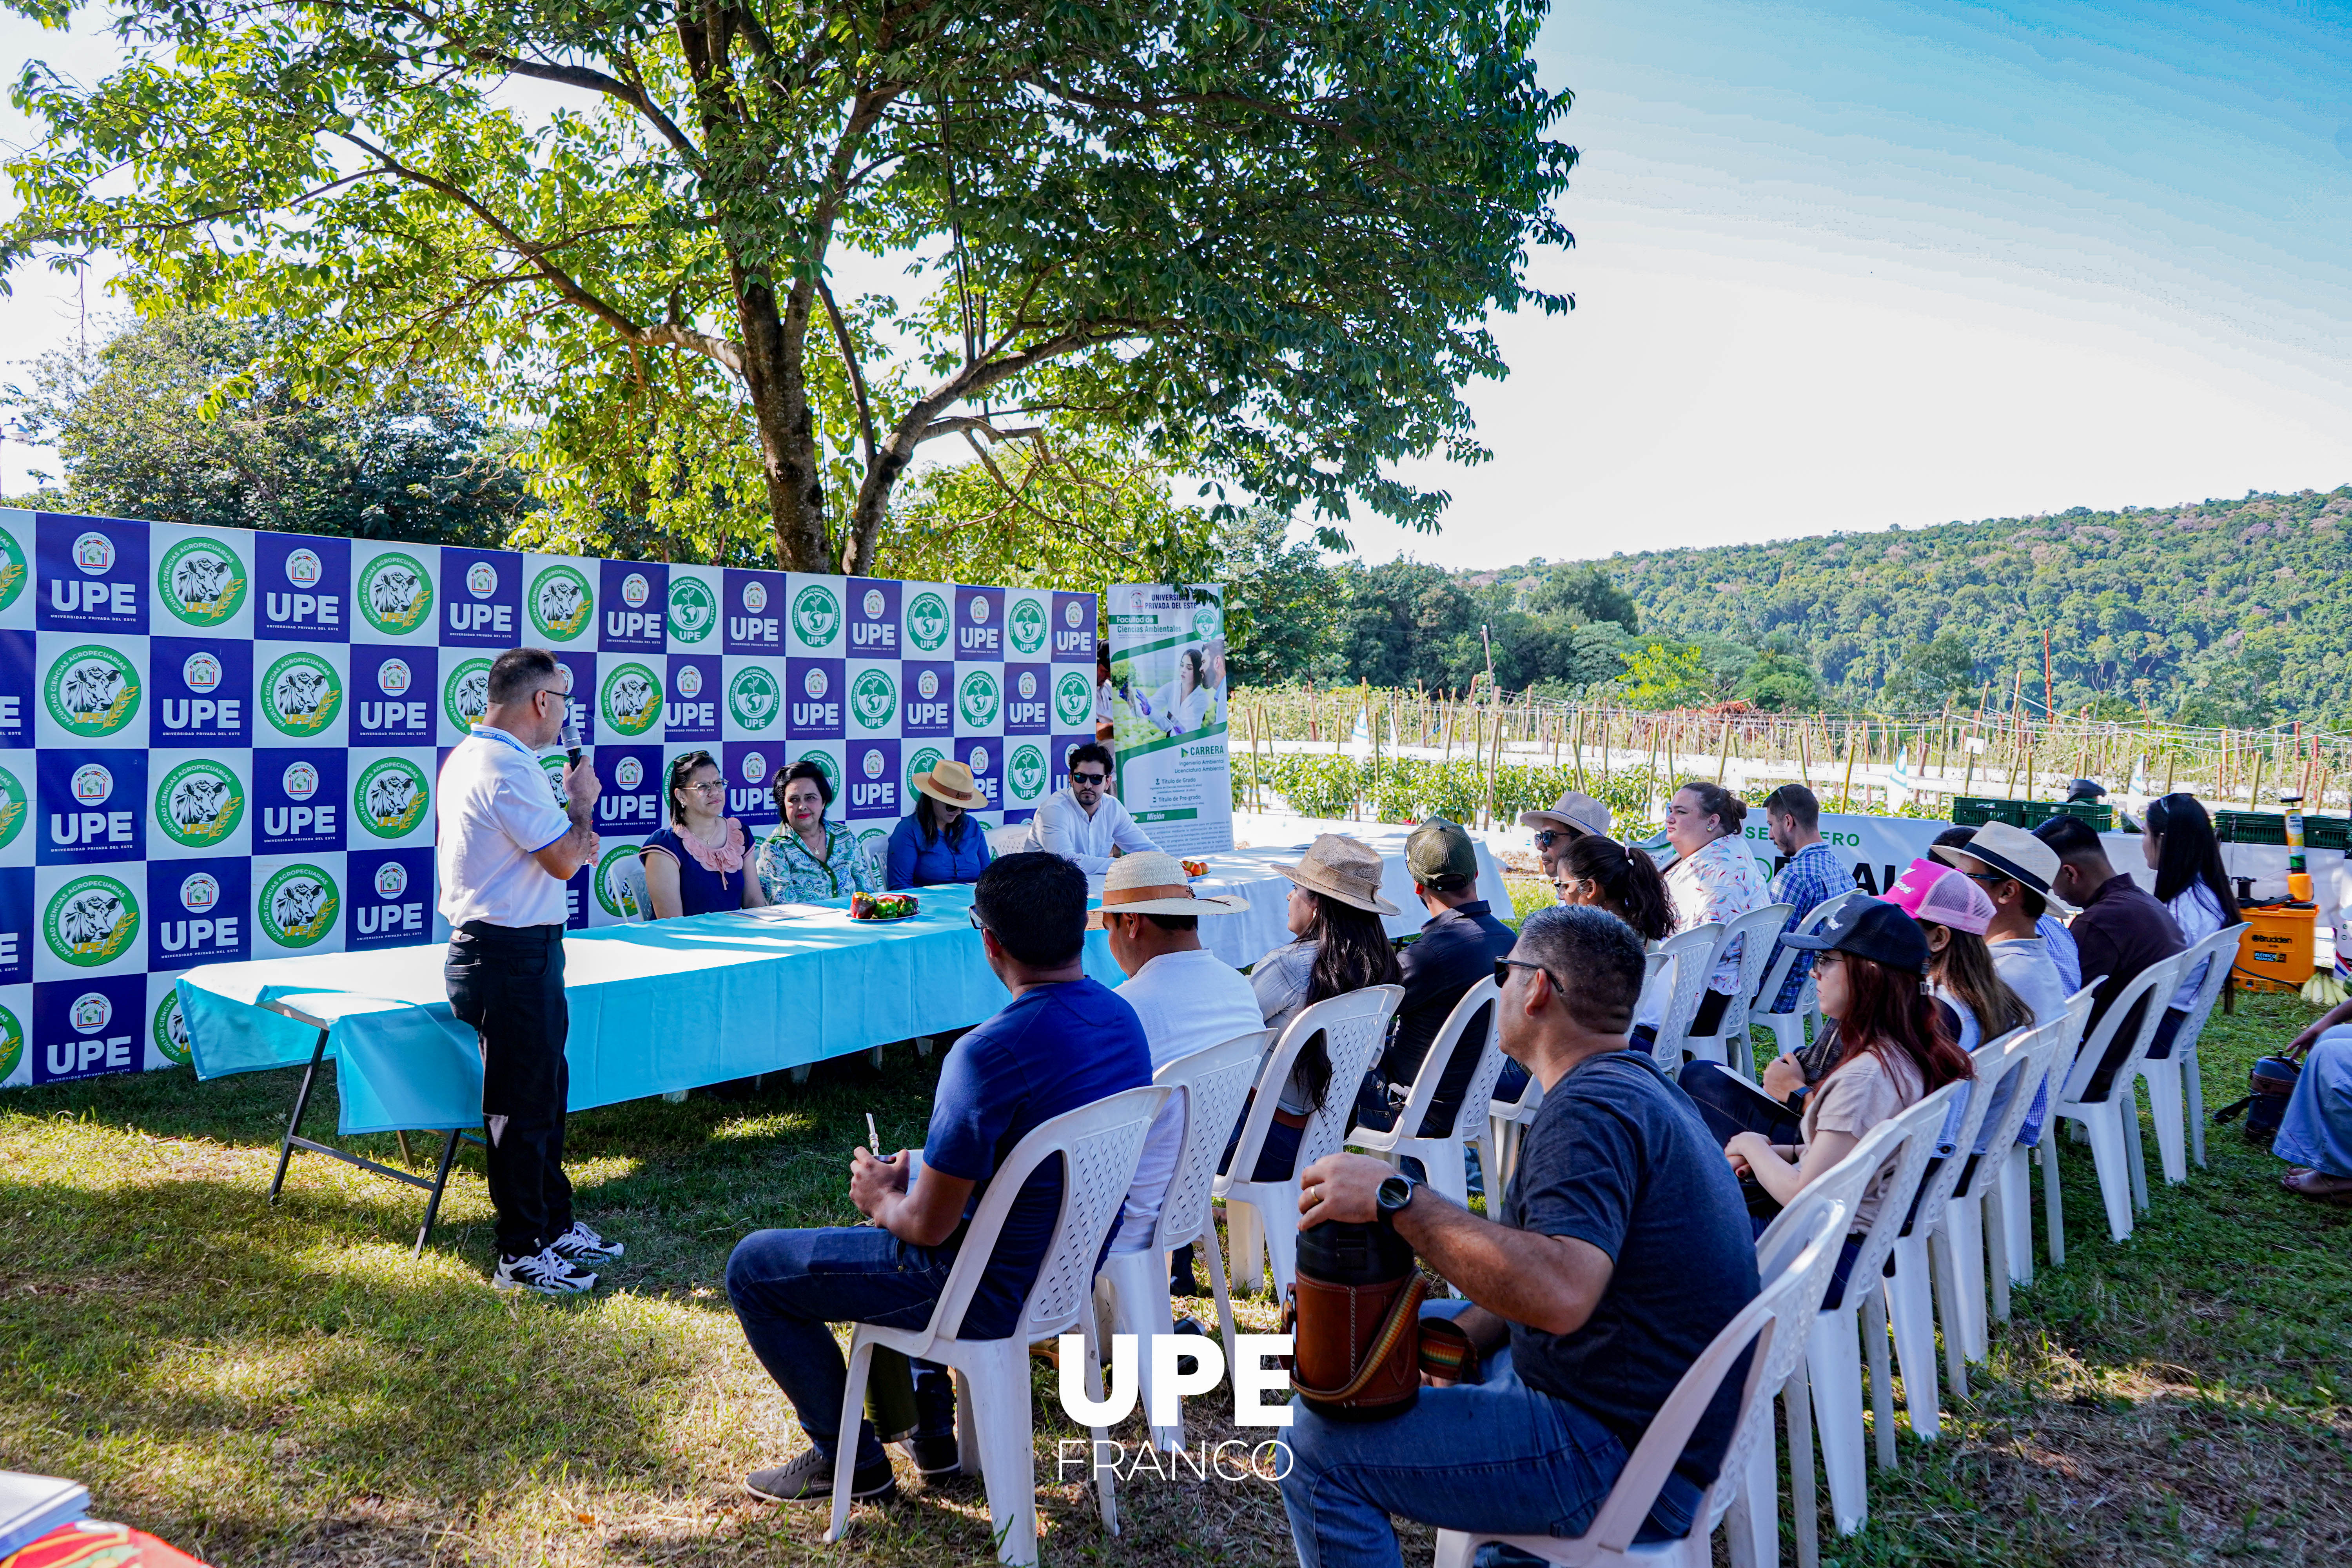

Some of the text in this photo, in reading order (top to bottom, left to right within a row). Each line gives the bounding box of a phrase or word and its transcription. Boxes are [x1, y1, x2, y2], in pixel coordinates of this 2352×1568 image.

[164, 543, 233, 614] FACULTAD CIENCIAS AGROPECUARIAS
[363, 557, 422, 623] FACULTAD CIENCIAS AGROPECUARIAS
[52, 579, 136, 614] UPE
[185, 602, 213, 614] UPE
[267, 592, 338, 624] UPE
[532, 570, 584, 631] FACULTAD CIENCIAS AGROPECUARIAS
[702, 586, 715, 624] AMBIENTALES
[381, 612, 405, 623] UPE
[450, 603, 512, 631] UPE
[548, 620, 568, 630] UPE
[608, 612, 661, 638] UPE
[679, 631, 701, 641] UPE
[731, 617, 778, 641] UPE
[853, 623, 895, 645] UPE
[961, 627, 998, 648] UPE
[807, 636, 826, 646] UPE
[920, 640, 937, 649] UPE
[1056, 631, 1091, 651] UPE
[51, 651, 127, 725] FACULTAD CIENCIAS AGROPECUARIAS
[266, 657, 330, 726] FACULTAD CIENCIAS AGROPECUARIAS
[448, 663, 492, 727] FACULTAD CIENCIAS AGROPECU
[605, 667, 652, 726] FACULTAD CIENCIAS AGROPECUARIAS
[74, 712, 105, 724] UPE
[163, 699, 240, 728] UPE
[285, 714, 311, 724] UPE
[361, 702, 426, 729] UPE
[619, 716, 638, 725] UPE
[665, 703, 714, 726] UPE
[745, 719, 765, 728] UPE
[793, 703, 838, 725] UPE
[865, 718, 883, 727] UPE
[908, 703, 947, 724] UPE
[1009, 703, 1045, 723] UPE
[497, 735, 515, 747] WINNER
[1191, 746, 1224, 755] CARRERA
[359, 762, 418, 829] FACULTAD CIENCIAS AGROPECUARIAS
[731, 788, 776, 811] UPE
[853, 783, 894, 805] UPE
[974, 778, 998, 798] PE
[162, 765, 231, 837] FACULTAD CIENCIAS AGROPECUARIAS
[601, 795, 656, 820] UPE
[51, 812, 132, 844] UPE
[183, 823, 211, 835] UPE
[265, 806, 335, 835] UPE
[377, 816, 401, 827] UPE
[598, 859, 610, 884] CIENCIAS
[264, 869, 328, 939] FACULTAD CIENCIAS AGROPECUARIAS
[599, 886, 613, 909] FACULTAD
[50, 881, 125, 957] FACULTAD CIENCIAS AGROPECUARIAS
[358, 903, 422, 933] UPE
[161, 917, 238, 951] UPE
[284, 924, 309, 937] UPE
[2259, 935, 2292, 944] Brudden
[73, 941, 104, 955] UPE
[159, 997, 180, 1056] FACULTAD CIENCIAS
[47, 1036, 131, 1074] UPE
